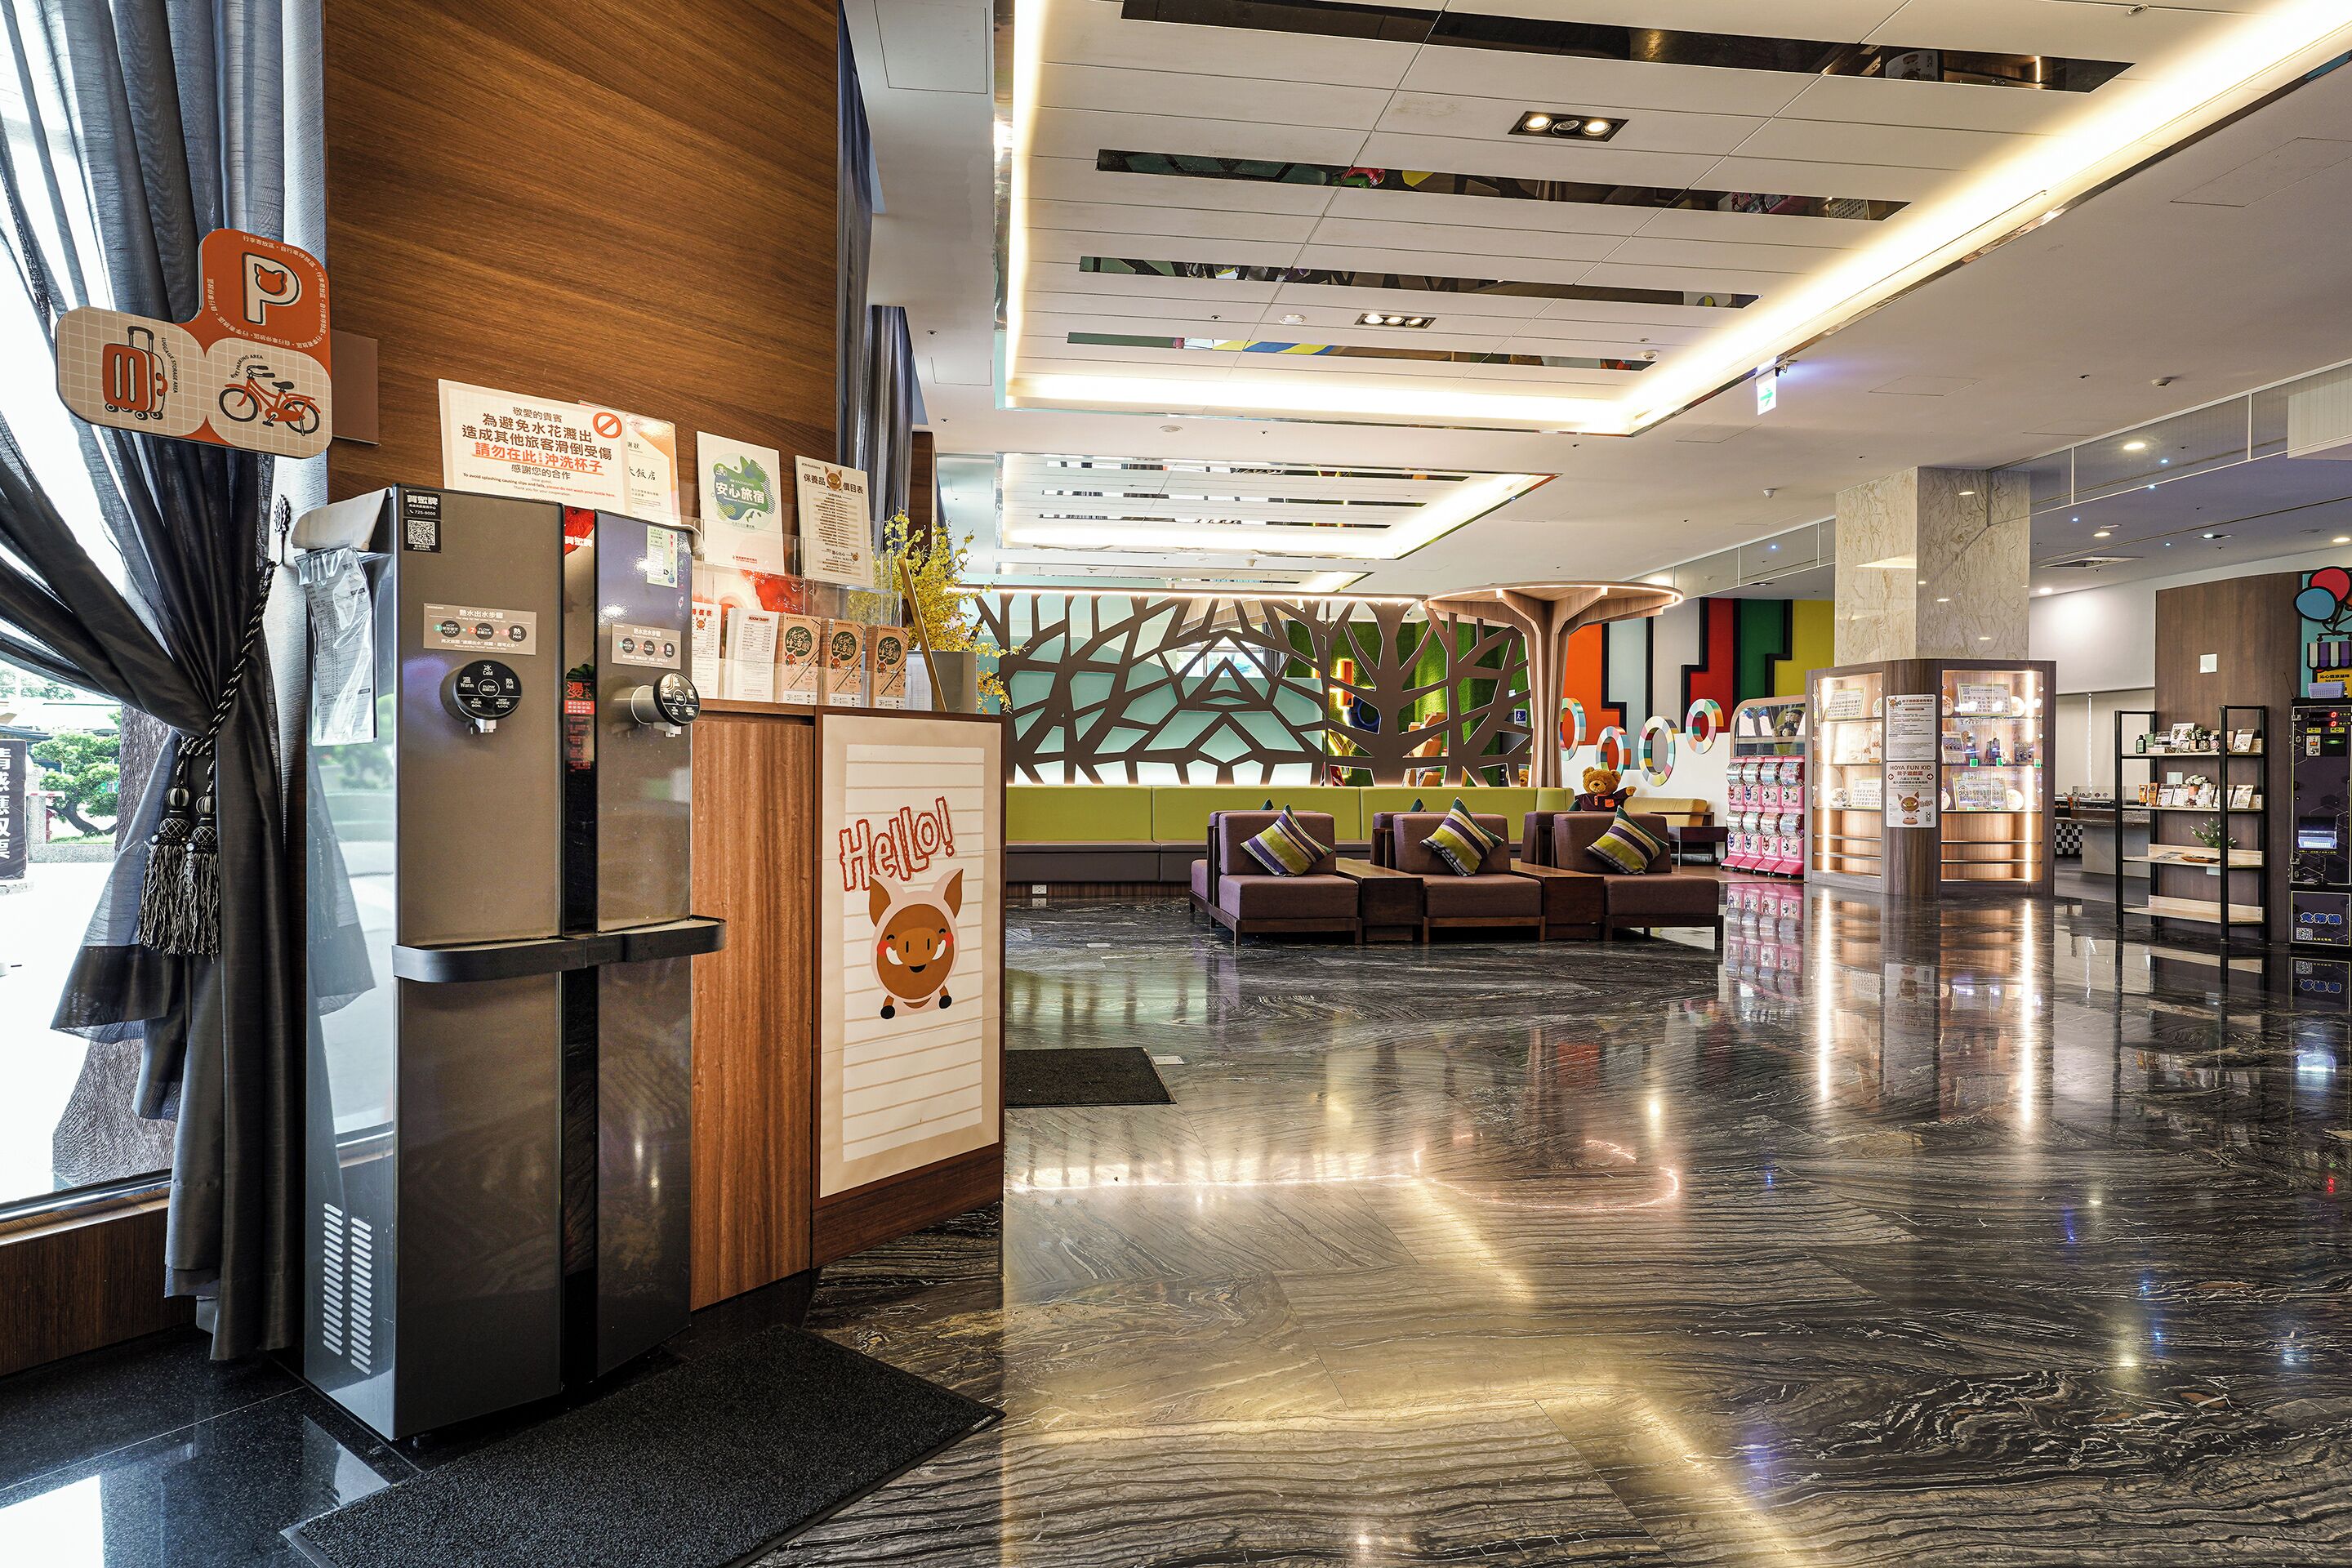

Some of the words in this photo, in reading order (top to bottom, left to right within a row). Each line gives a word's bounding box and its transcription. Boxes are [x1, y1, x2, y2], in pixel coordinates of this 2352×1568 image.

[242, 252, 302, 326] P
[161, 337, 174, 360] LUGGAGE
[235, 355, 249, 371] PARKING
[512, 407, 563, 424] 敬愛的貴賓
[482, 412, 592, 443] 為避免水花濺出
[461, 424, 612, 461] 造成其他旅客滑倒受傷
[474, 441, 537, 464] 請勿在此
[545, 452, 603, 473] 沖洗杯子
[511, 464, 571, 480] 感謝您的合作
[715, 482, 764, 504] 安心旅宿
[804, 473, 826, 486] 保養品
[843, 482, 864, 495] 價目表
[839, 795, 956, 892] Hello!
